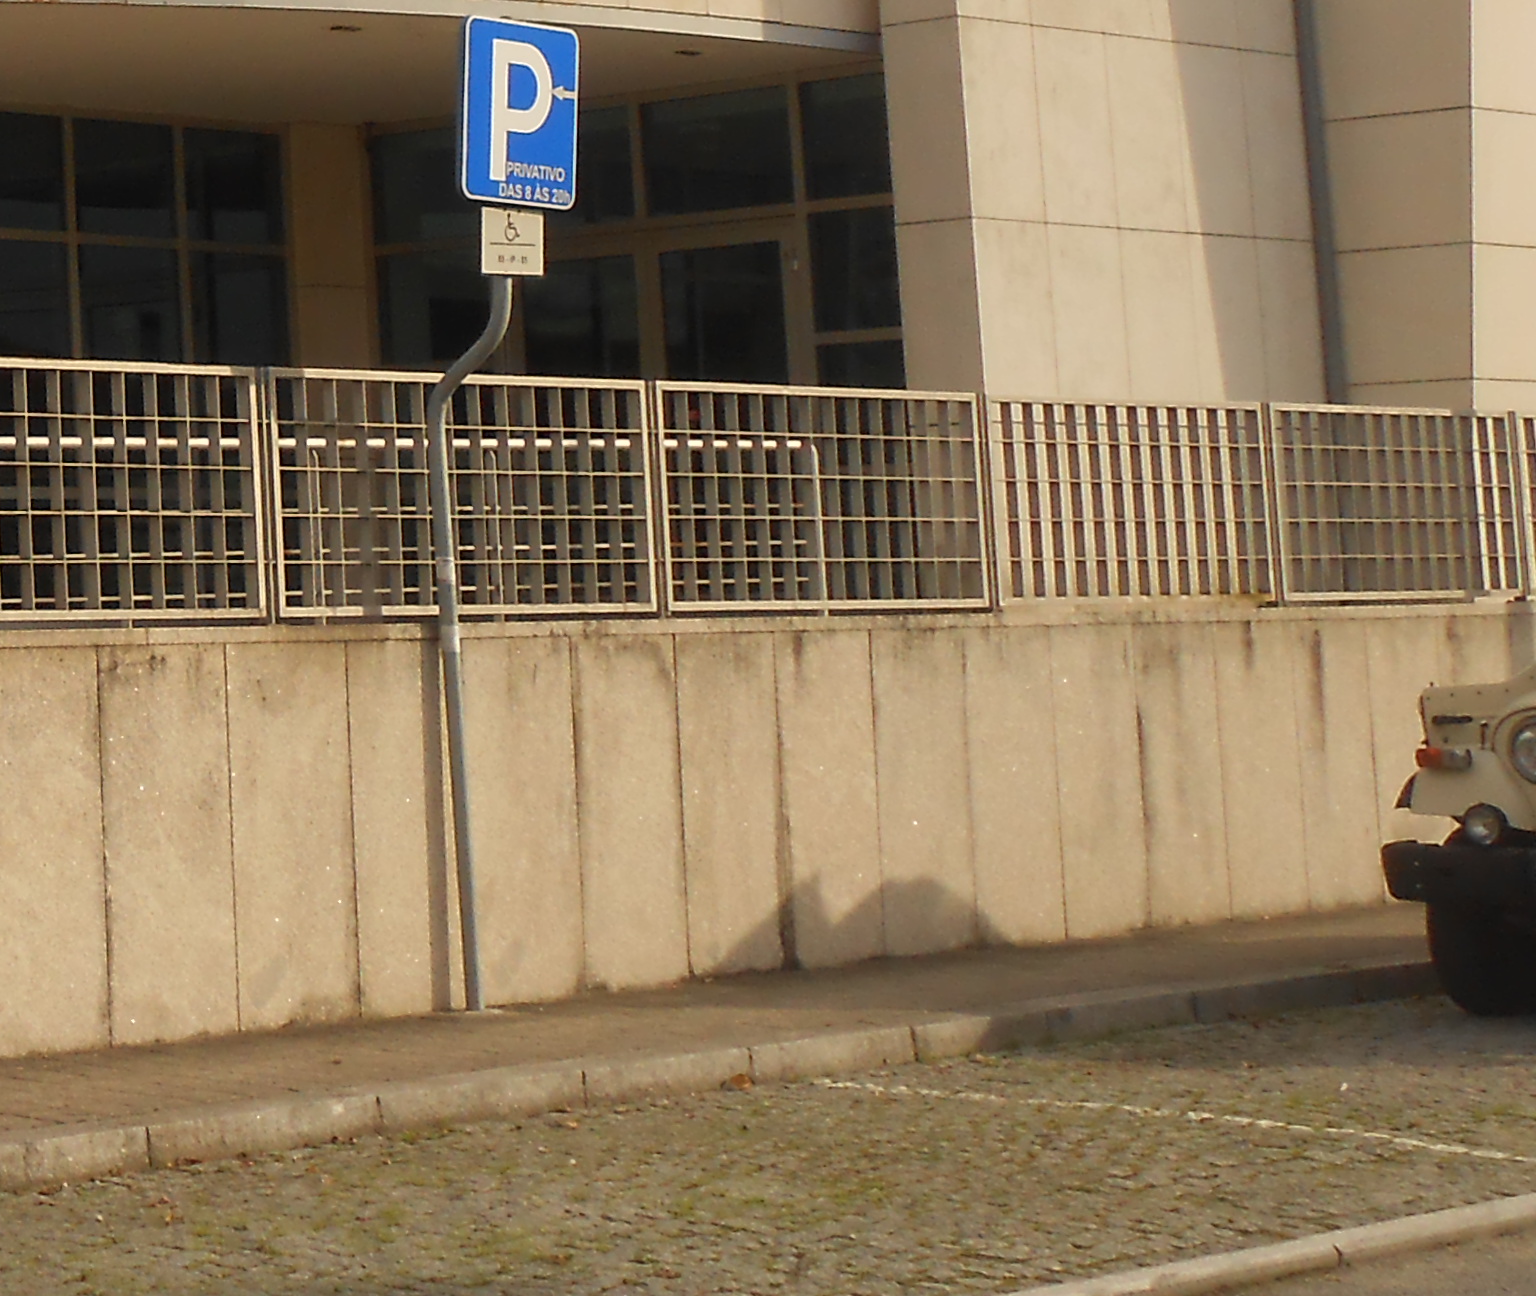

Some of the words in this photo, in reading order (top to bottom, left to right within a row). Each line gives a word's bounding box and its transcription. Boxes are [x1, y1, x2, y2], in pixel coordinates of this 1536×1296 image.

[507, 161, 566, 183] PRIVATIVO
[498, 182, 523, 199] DAS
[524, 185, 532, 201] 8
[533, 183, 550, 202] ÀS
